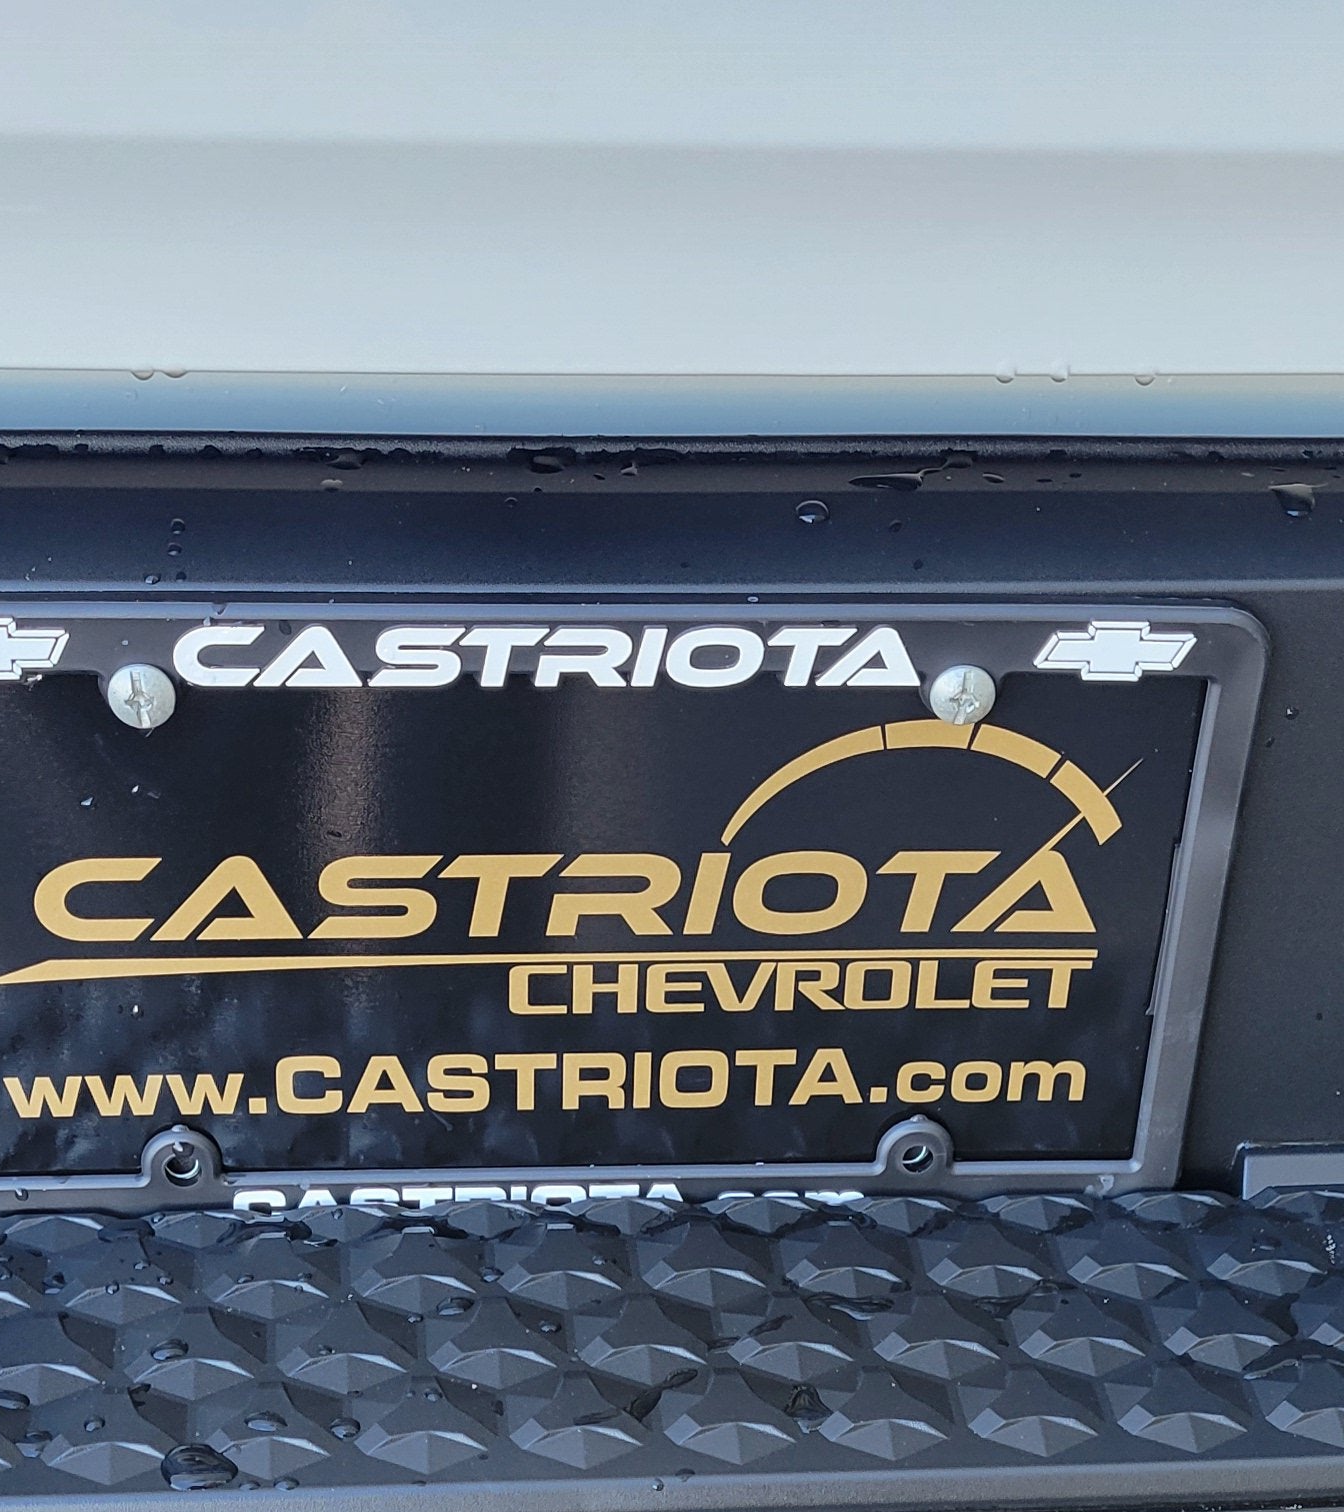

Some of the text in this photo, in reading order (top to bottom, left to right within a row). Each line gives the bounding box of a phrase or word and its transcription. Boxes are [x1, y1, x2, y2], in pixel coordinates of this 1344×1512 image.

[171, 625, 921, 688] CASTRIOTA
[33, 848, 1097, 942] CASTRIOTA
[508, 959, 1094, 1015] CHEVROLET
[3, 1048, 1086, 1118] www.CASTRIOTA.com
